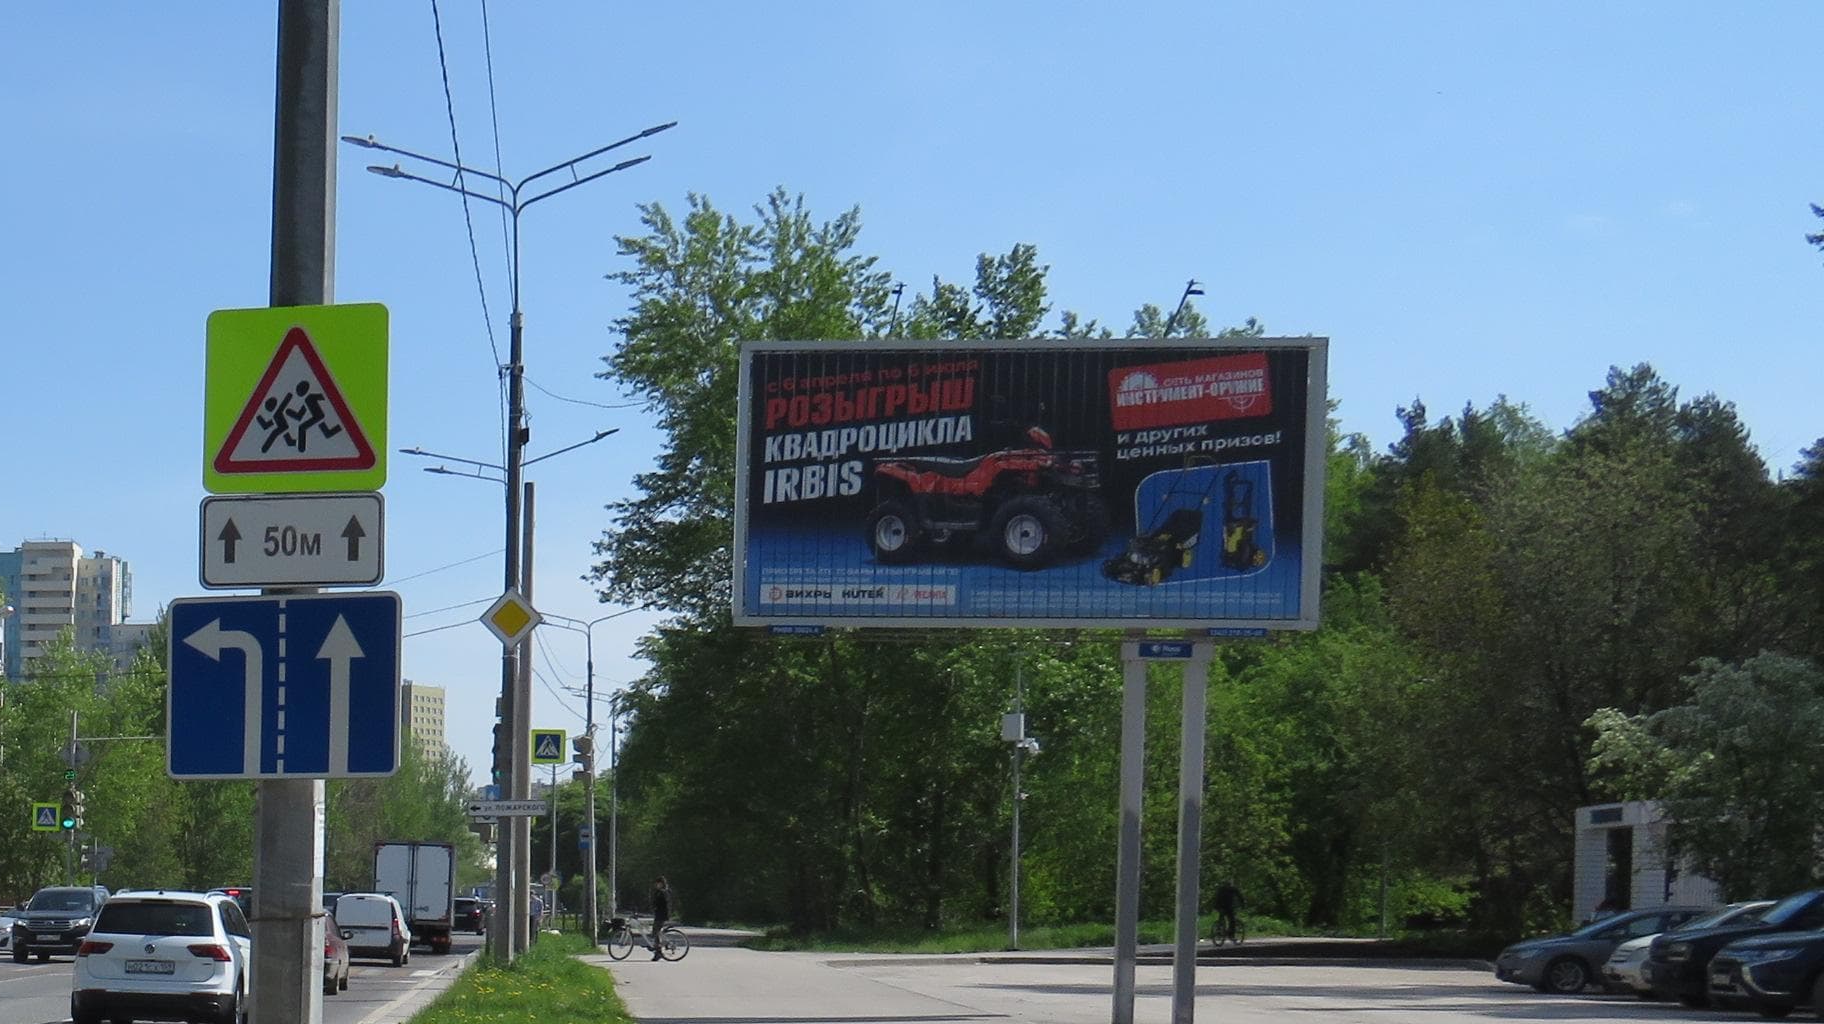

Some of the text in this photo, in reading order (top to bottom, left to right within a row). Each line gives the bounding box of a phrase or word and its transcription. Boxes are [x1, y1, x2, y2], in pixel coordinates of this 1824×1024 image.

[1194, 369, 1264, 383] МАГАЗИНОВ
[765, 377, 975, 430] РОЗЫГРЫШ
[764, 415, 973, 463] КВАДРОЦИКЛА
[1116, 430, 1282, 460] ценных призов!
[1135, 425, 1209, 445] других
[763, 460, 864, 504] IRBIS
